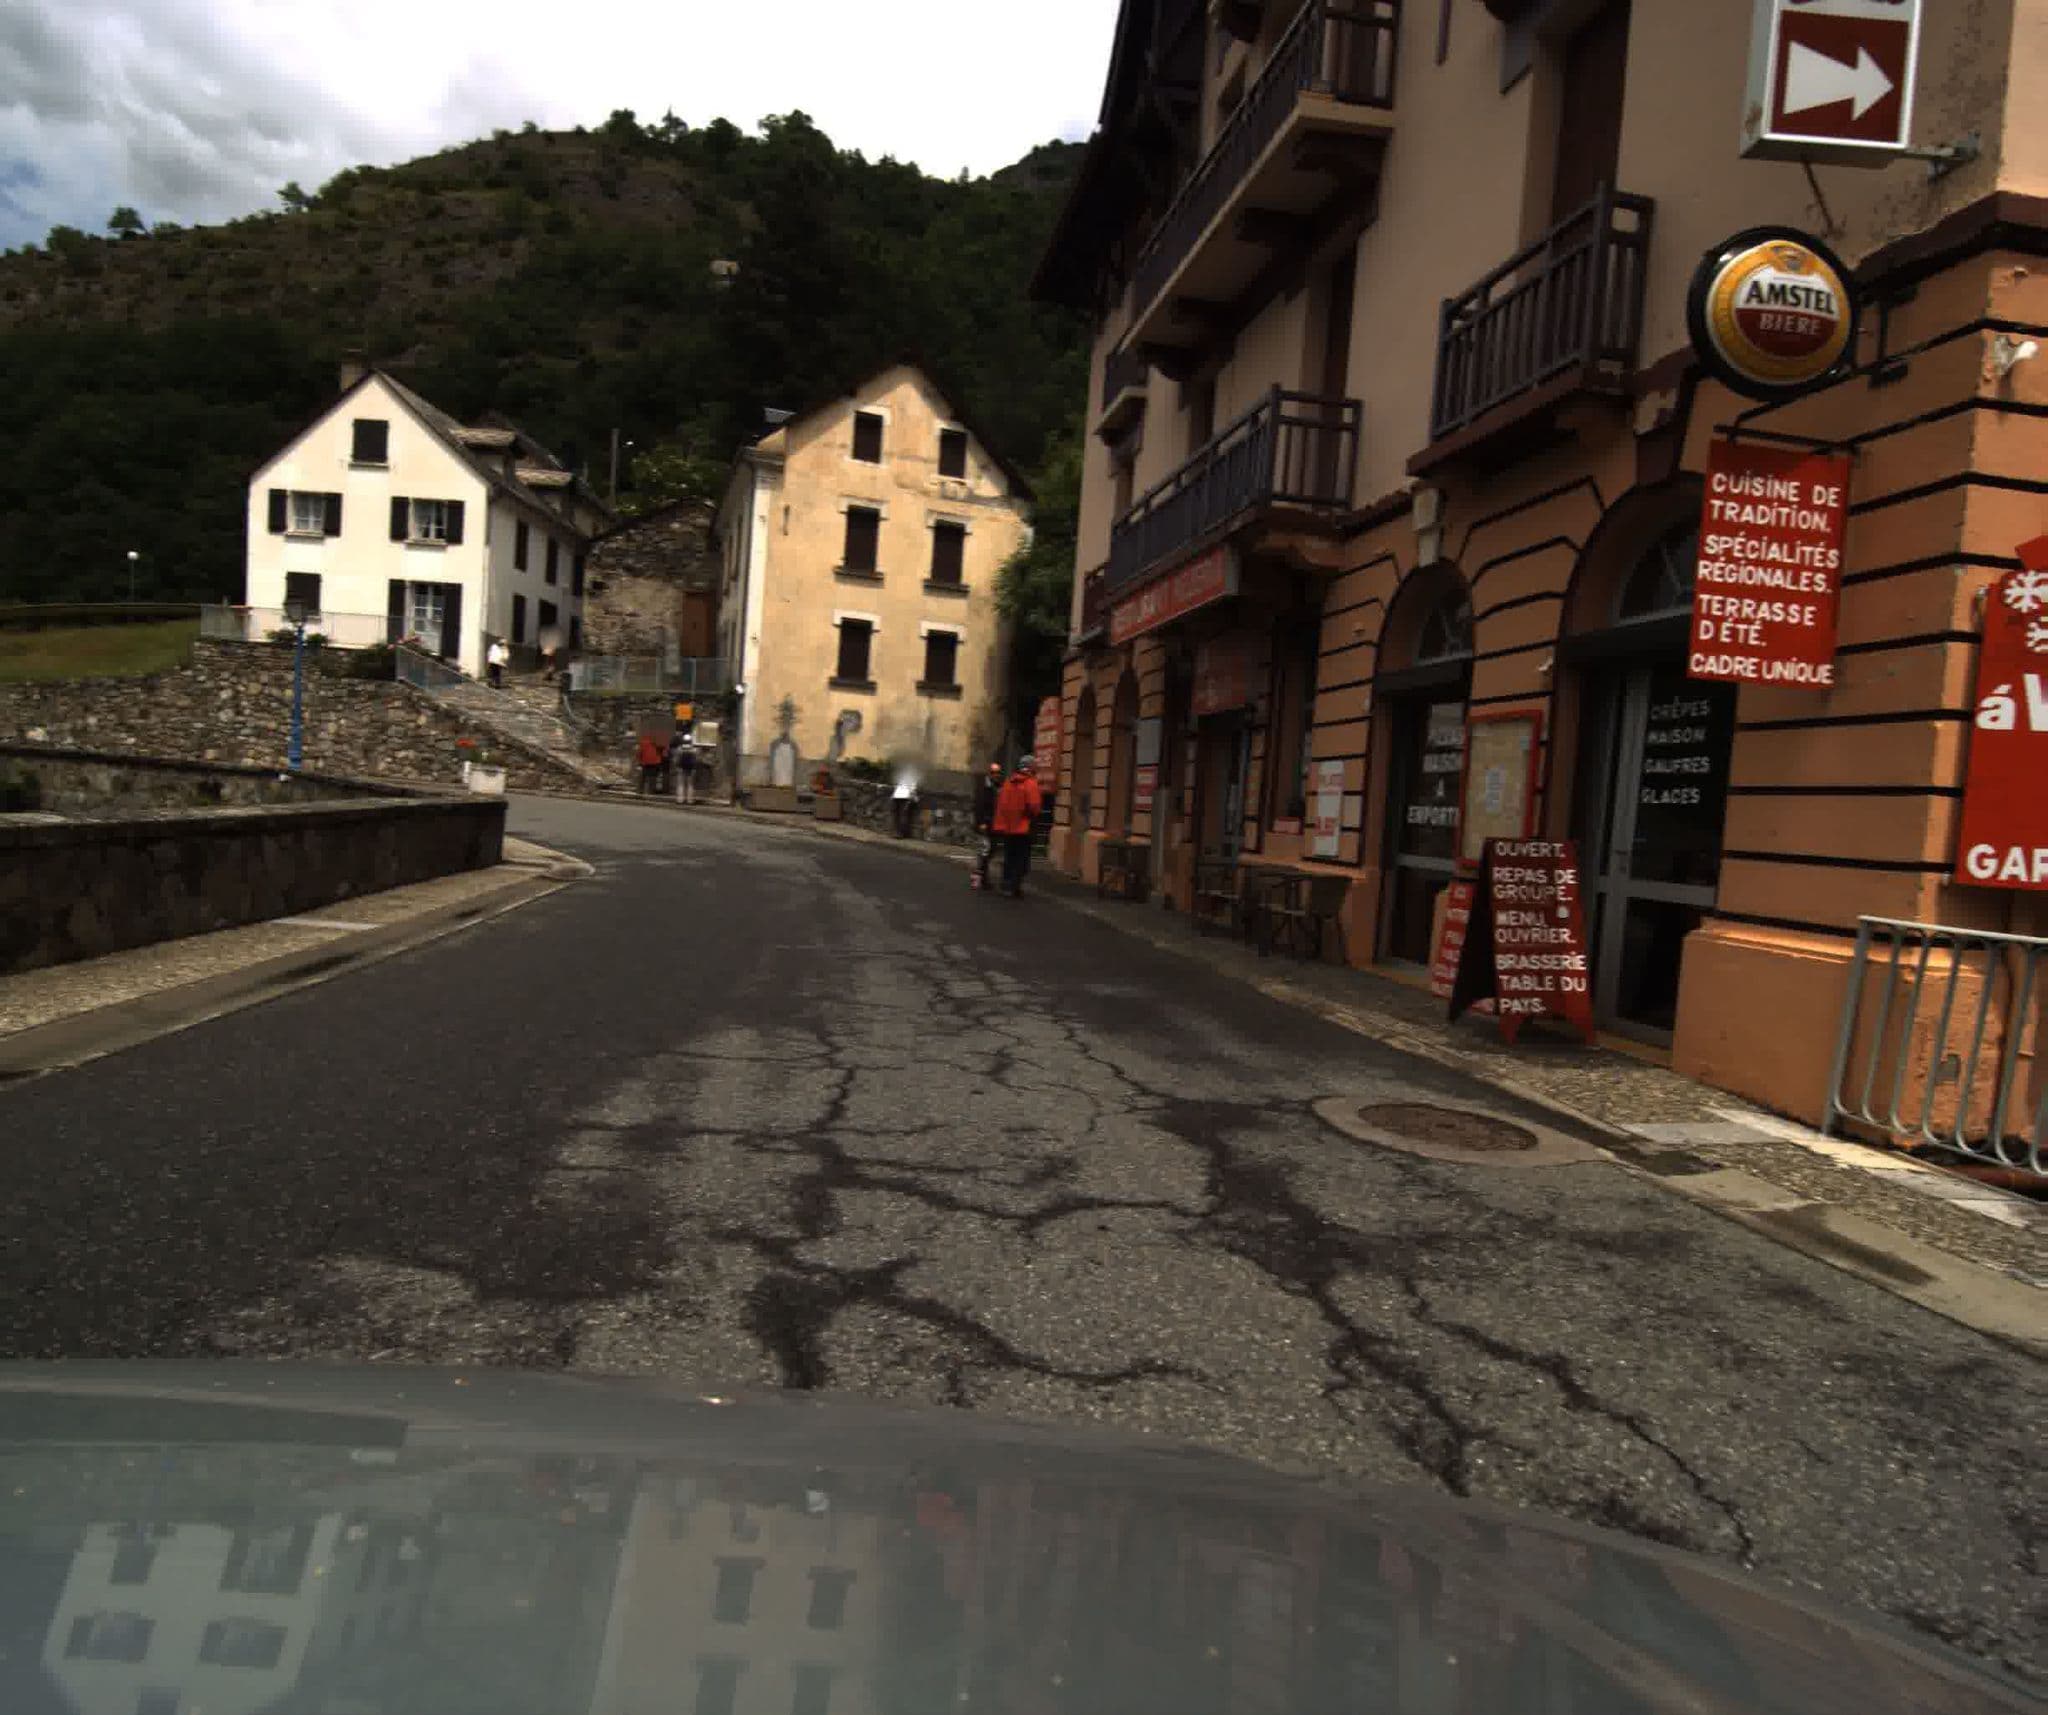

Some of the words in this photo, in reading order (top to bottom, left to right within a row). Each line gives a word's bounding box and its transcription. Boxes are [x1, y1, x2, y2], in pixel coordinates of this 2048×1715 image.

[1745, 280, 1836, 314] AMSTEL
[1711, 470, 1801, 502] CUISINE
[1812, 484, 1841, 507] DE
[1704, 531, 1841, 569] SPÉCIALITÉS
[1698, 594, 1818, 626] TERRASSE
[1689, 653, 1760, 678] CADRE
[1761, 657, 1835, 684] UNIQUE
[1554, 869, 1579, 885] DE
[1496, 951, 1587, 970] BRASSERIE
[1499, 974, 1555, 992] TABLE
[1561, 976, 1587, 992] DU
